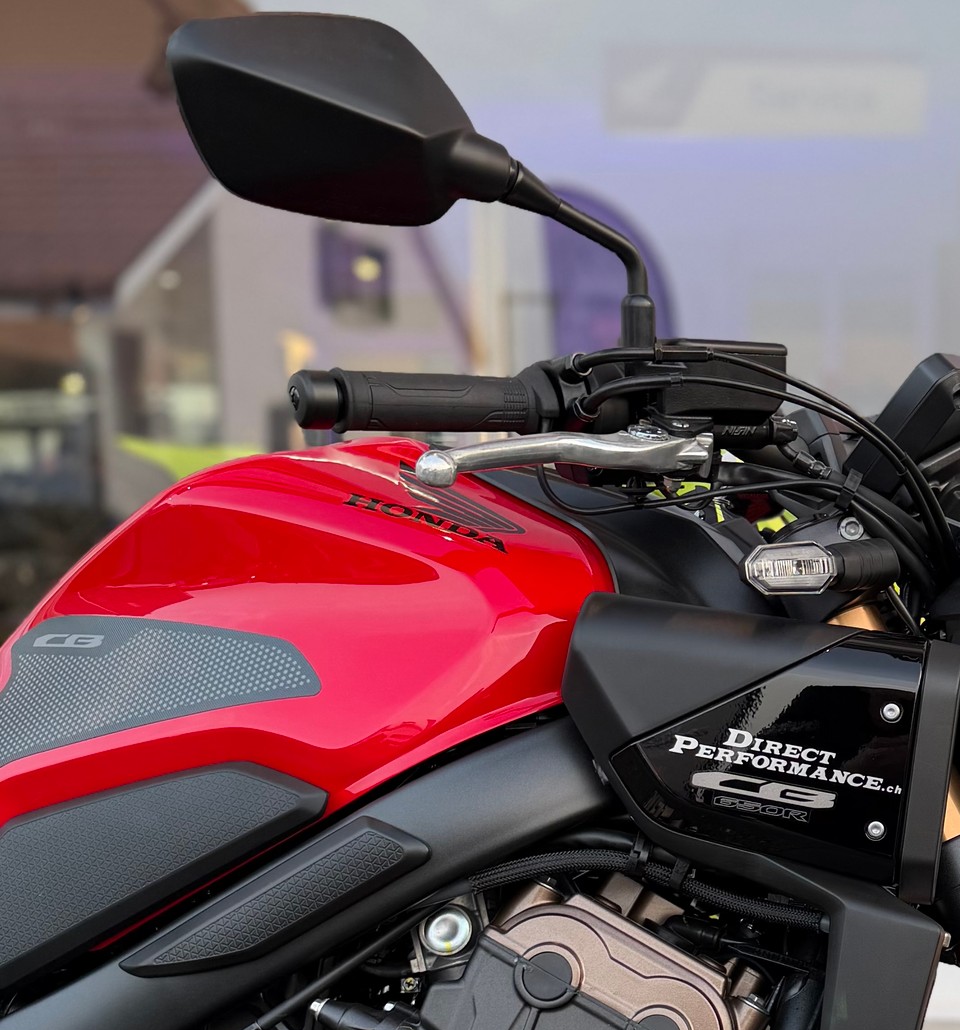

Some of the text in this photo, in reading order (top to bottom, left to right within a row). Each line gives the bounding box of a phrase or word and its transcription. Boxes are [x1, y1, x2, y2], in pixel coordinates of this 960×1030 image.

[343, 491, 510, 556] HONDA
[32, 632, 106, 649] CB
[668, 733, 903, 796] PERFORMANCE.ch
[721, 727, 837, 766] DIRECT
[690, 770, 839, 810] CB
[711, 794, 811, 824] 650R
